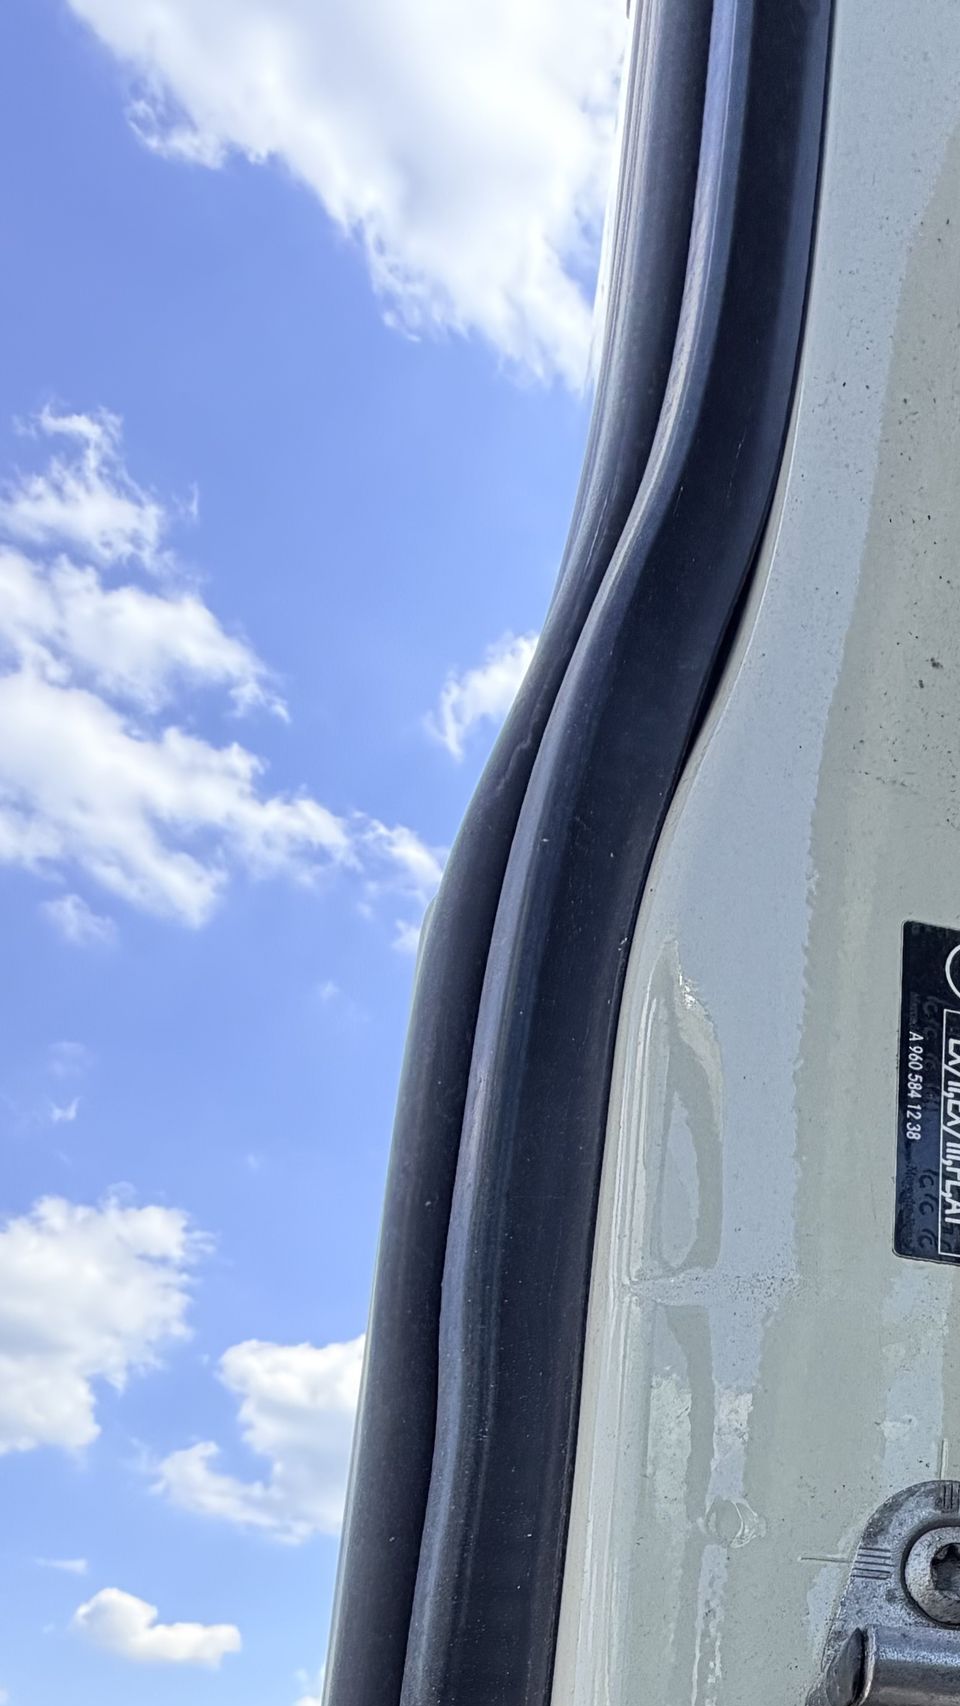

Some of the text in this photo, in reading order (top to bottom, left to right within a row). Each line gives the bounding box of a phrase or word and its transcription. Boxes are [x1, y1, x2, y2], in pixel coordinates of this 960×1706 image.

[909, 1031, 922, 1041] A
[908, 1046, 922, 1070] 960
[908, 1074, 921, 1098] 584
[907, 1104, 921, 1118] 12
[906, 1119, 920, 1140] 38
